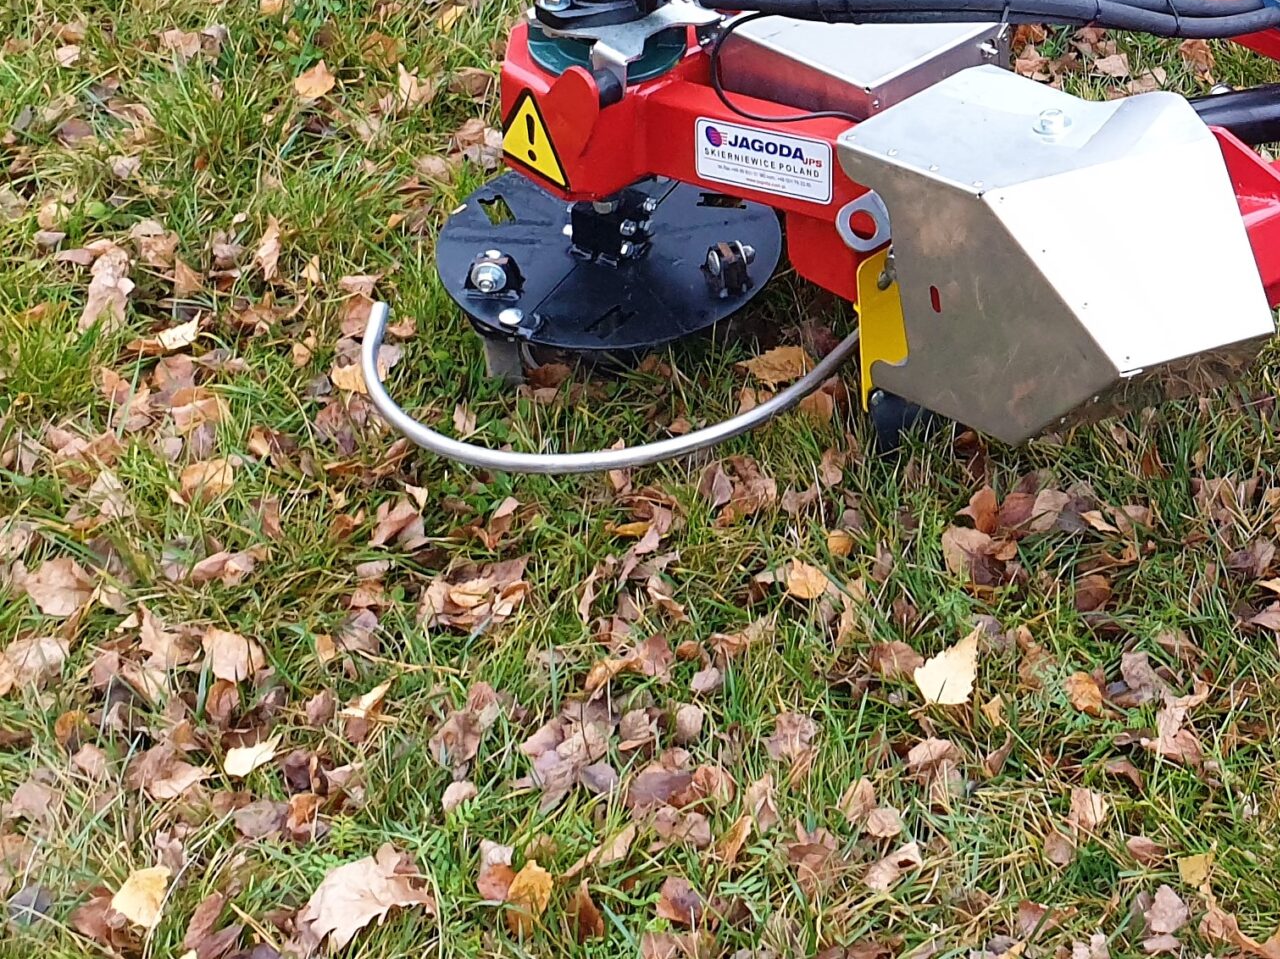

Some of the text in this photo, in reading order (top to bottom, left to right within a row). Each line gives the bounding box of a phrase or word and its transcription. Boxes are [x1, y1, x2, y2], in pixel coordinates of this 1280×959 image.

[704, 147, 776, 169] SKIERNIEWICE
[779, 162, 820, 178] POLAND
[728, 135, 823, 168] JAGODA JPS
